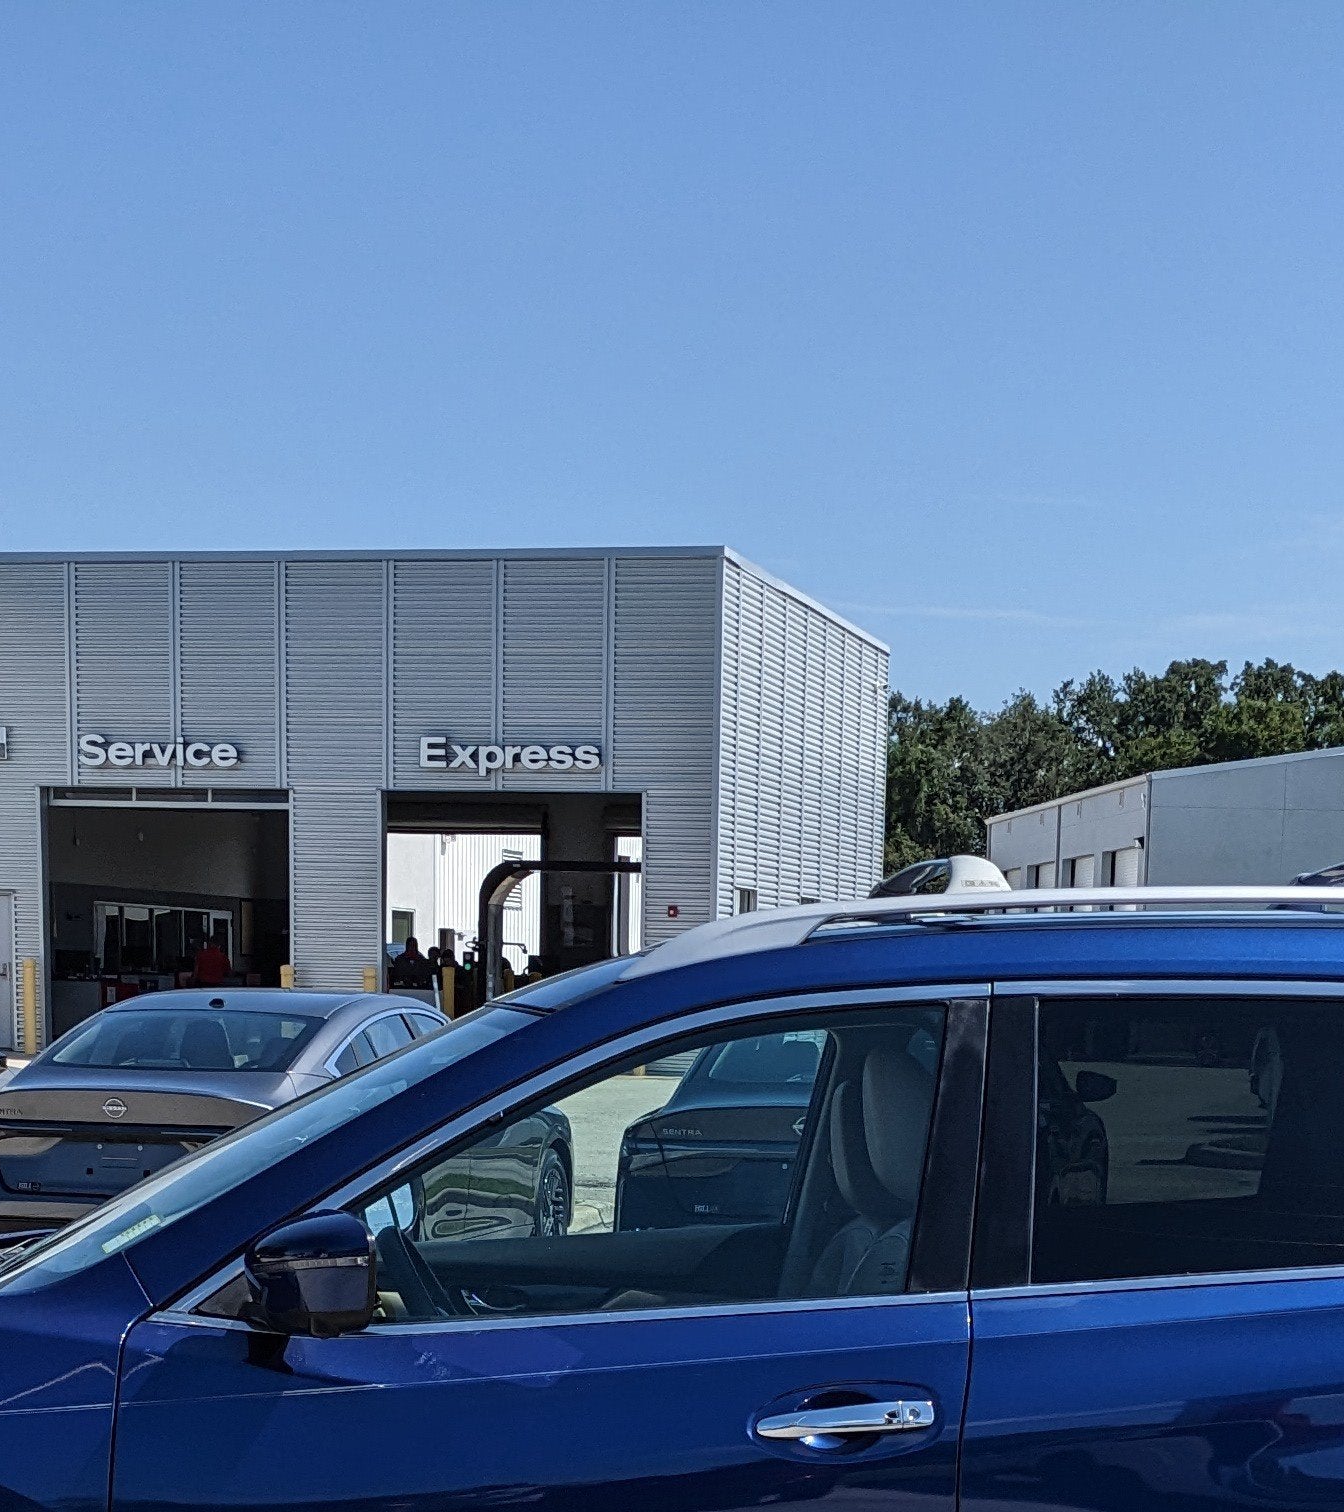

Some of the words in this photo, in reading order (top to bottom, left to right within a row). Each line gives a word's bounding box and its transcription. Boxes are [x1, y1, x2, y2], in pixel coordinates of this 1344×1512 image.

[78, 733, 239, 767] Service
[419, 736, 602, 777] Express
[662, 1128, 703, 1136] SENTRA
